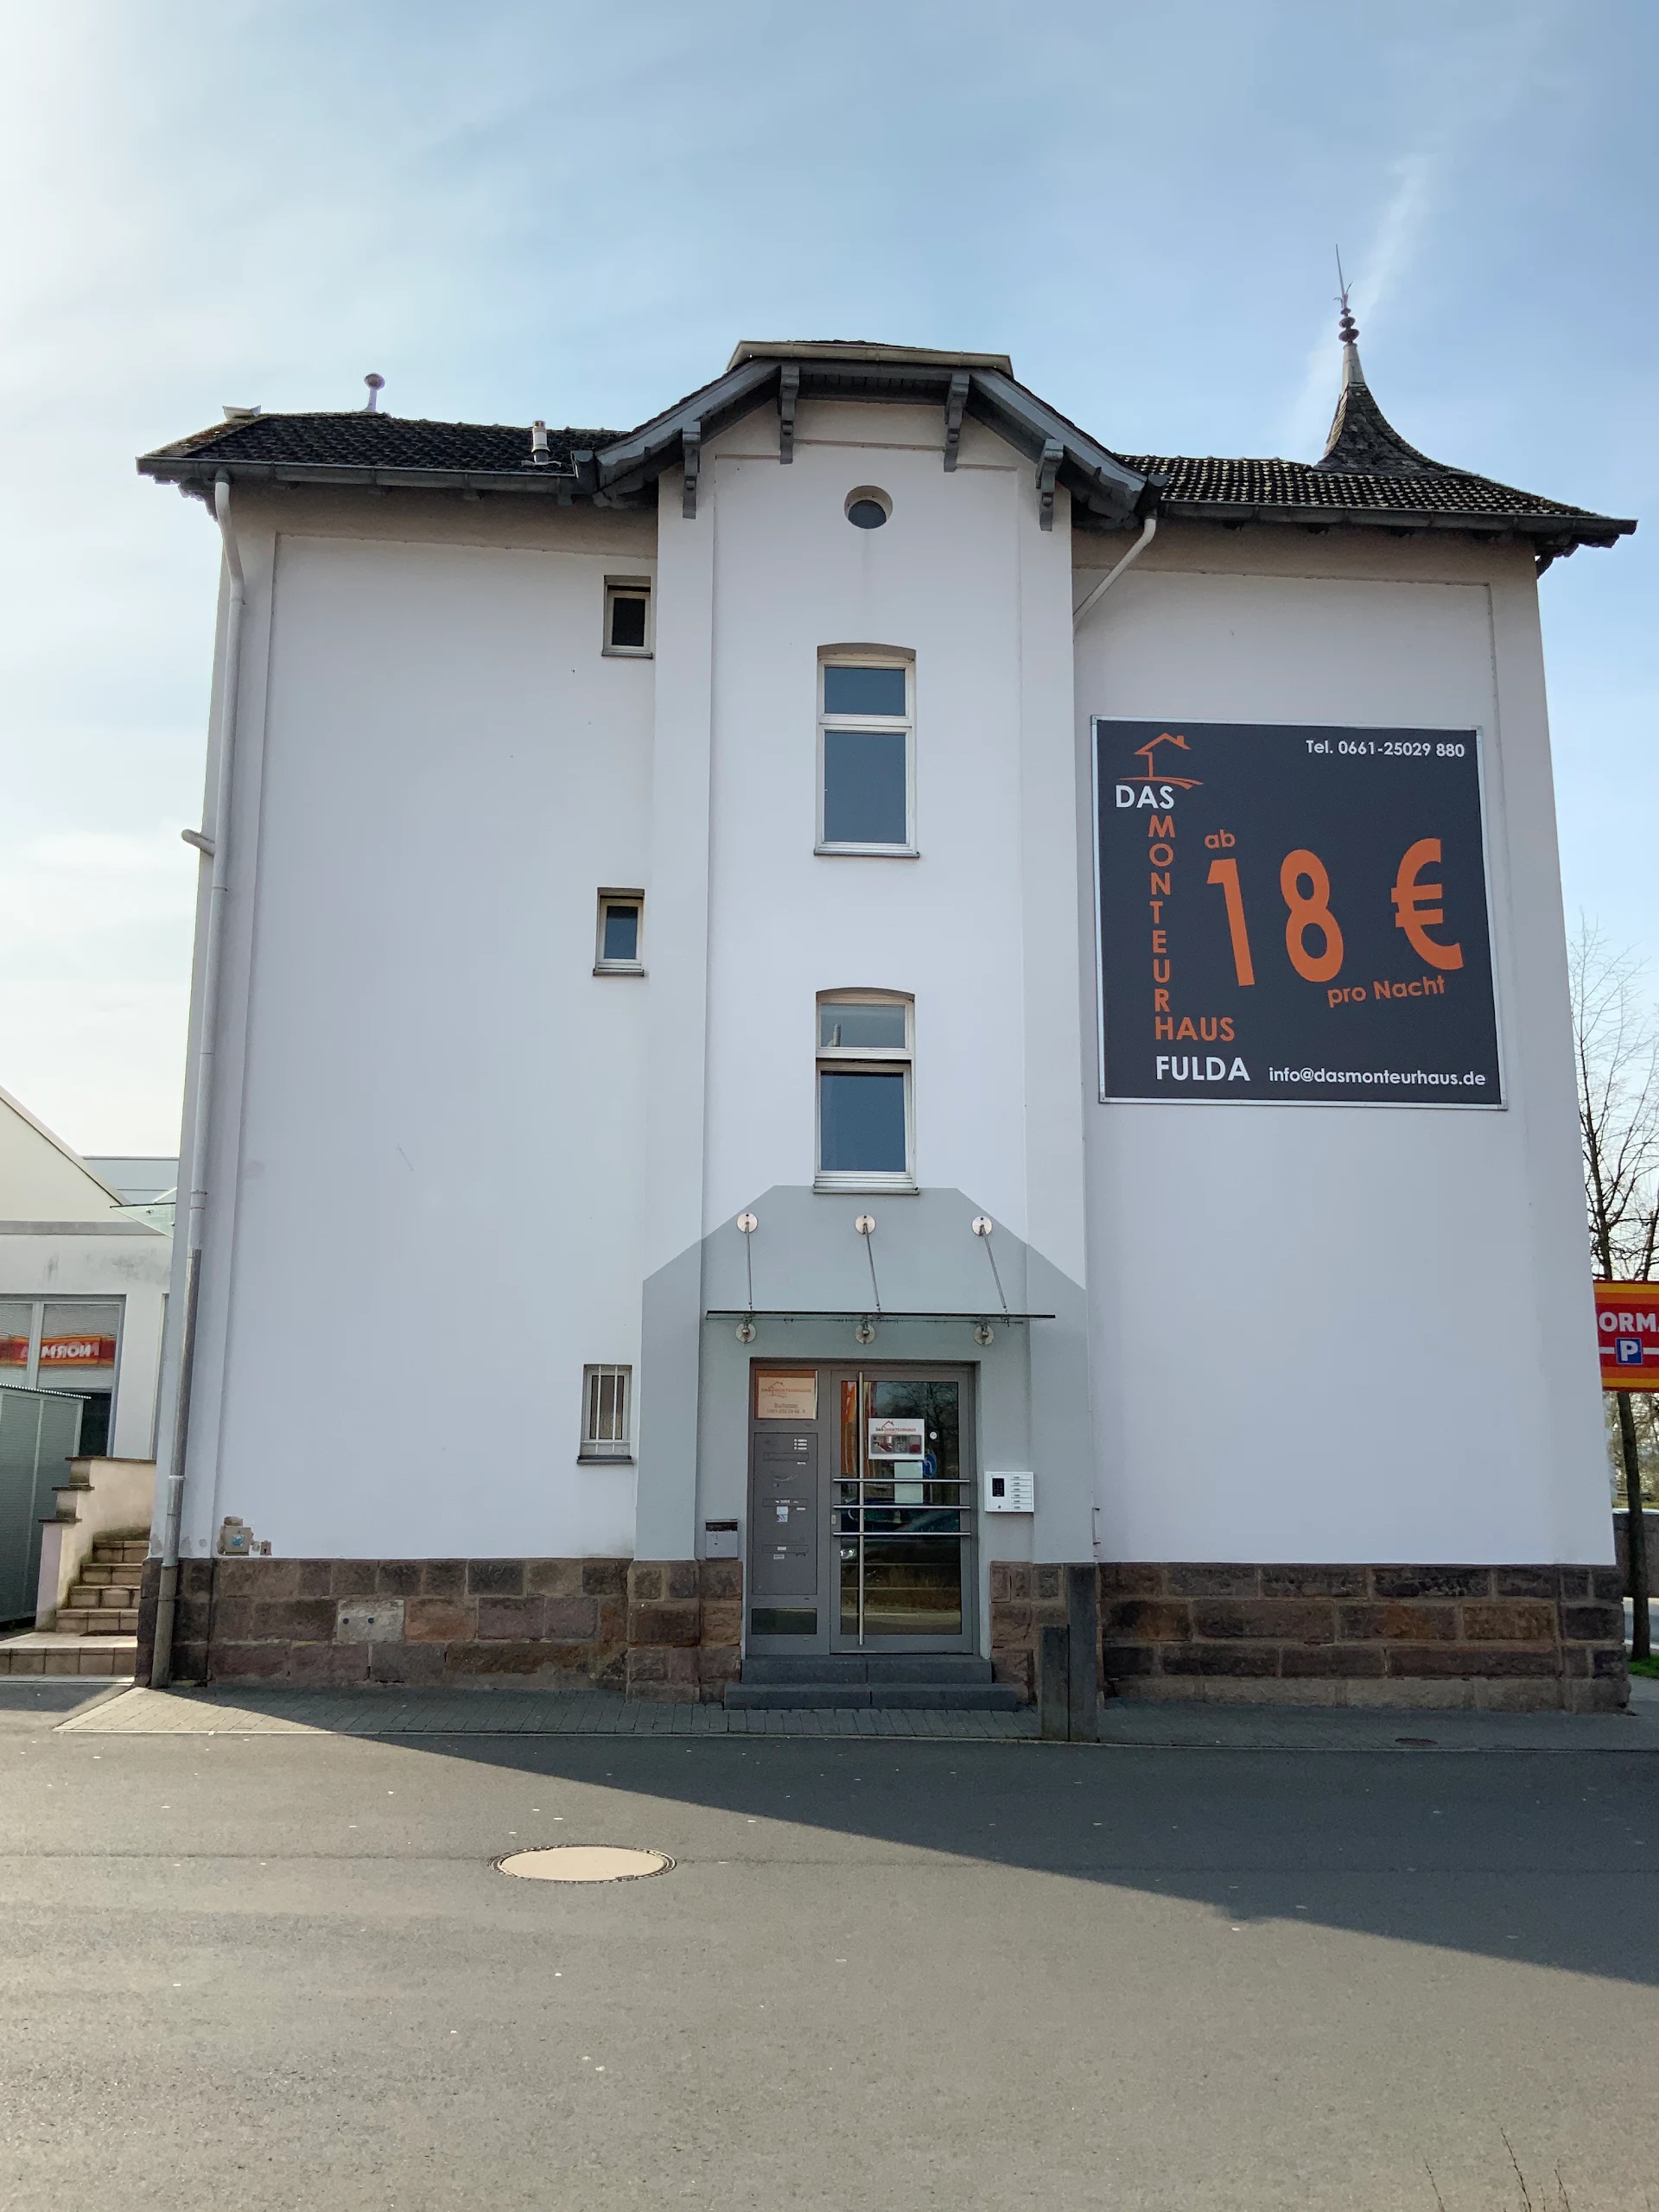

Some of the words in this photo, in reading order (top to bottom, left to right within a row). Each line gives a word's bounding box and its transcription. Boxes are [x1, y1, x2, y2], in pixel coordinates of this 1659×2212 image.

[1306, 740, 1333, 754] Tel.
[1338, 741, 1431, 757] 0661-25029
[1436, 743, 1465, 758] 880
[1116, 785, 1174, 810] DAS
[1205, 830, 1236, 849] ab
[1147, 815, 1175, 1013] MONTEUR
[1206, 849, 1344, 987] 18
[1390, 837, 1464, 971] €
[1327, 987, 1366, 1007] pro
[1374, 976, 1446, 1000] Nacht
[1155, 1016, 1235, 1041] HAUS
[1156, 1056, 1250, 1081] FULDA
[1268, 1066, 1485, 1086] info@dasmonteurhaus.de
[1599, 1310, 1659, 1332] ORM
[1620, 1340, 1638, 1362] P
